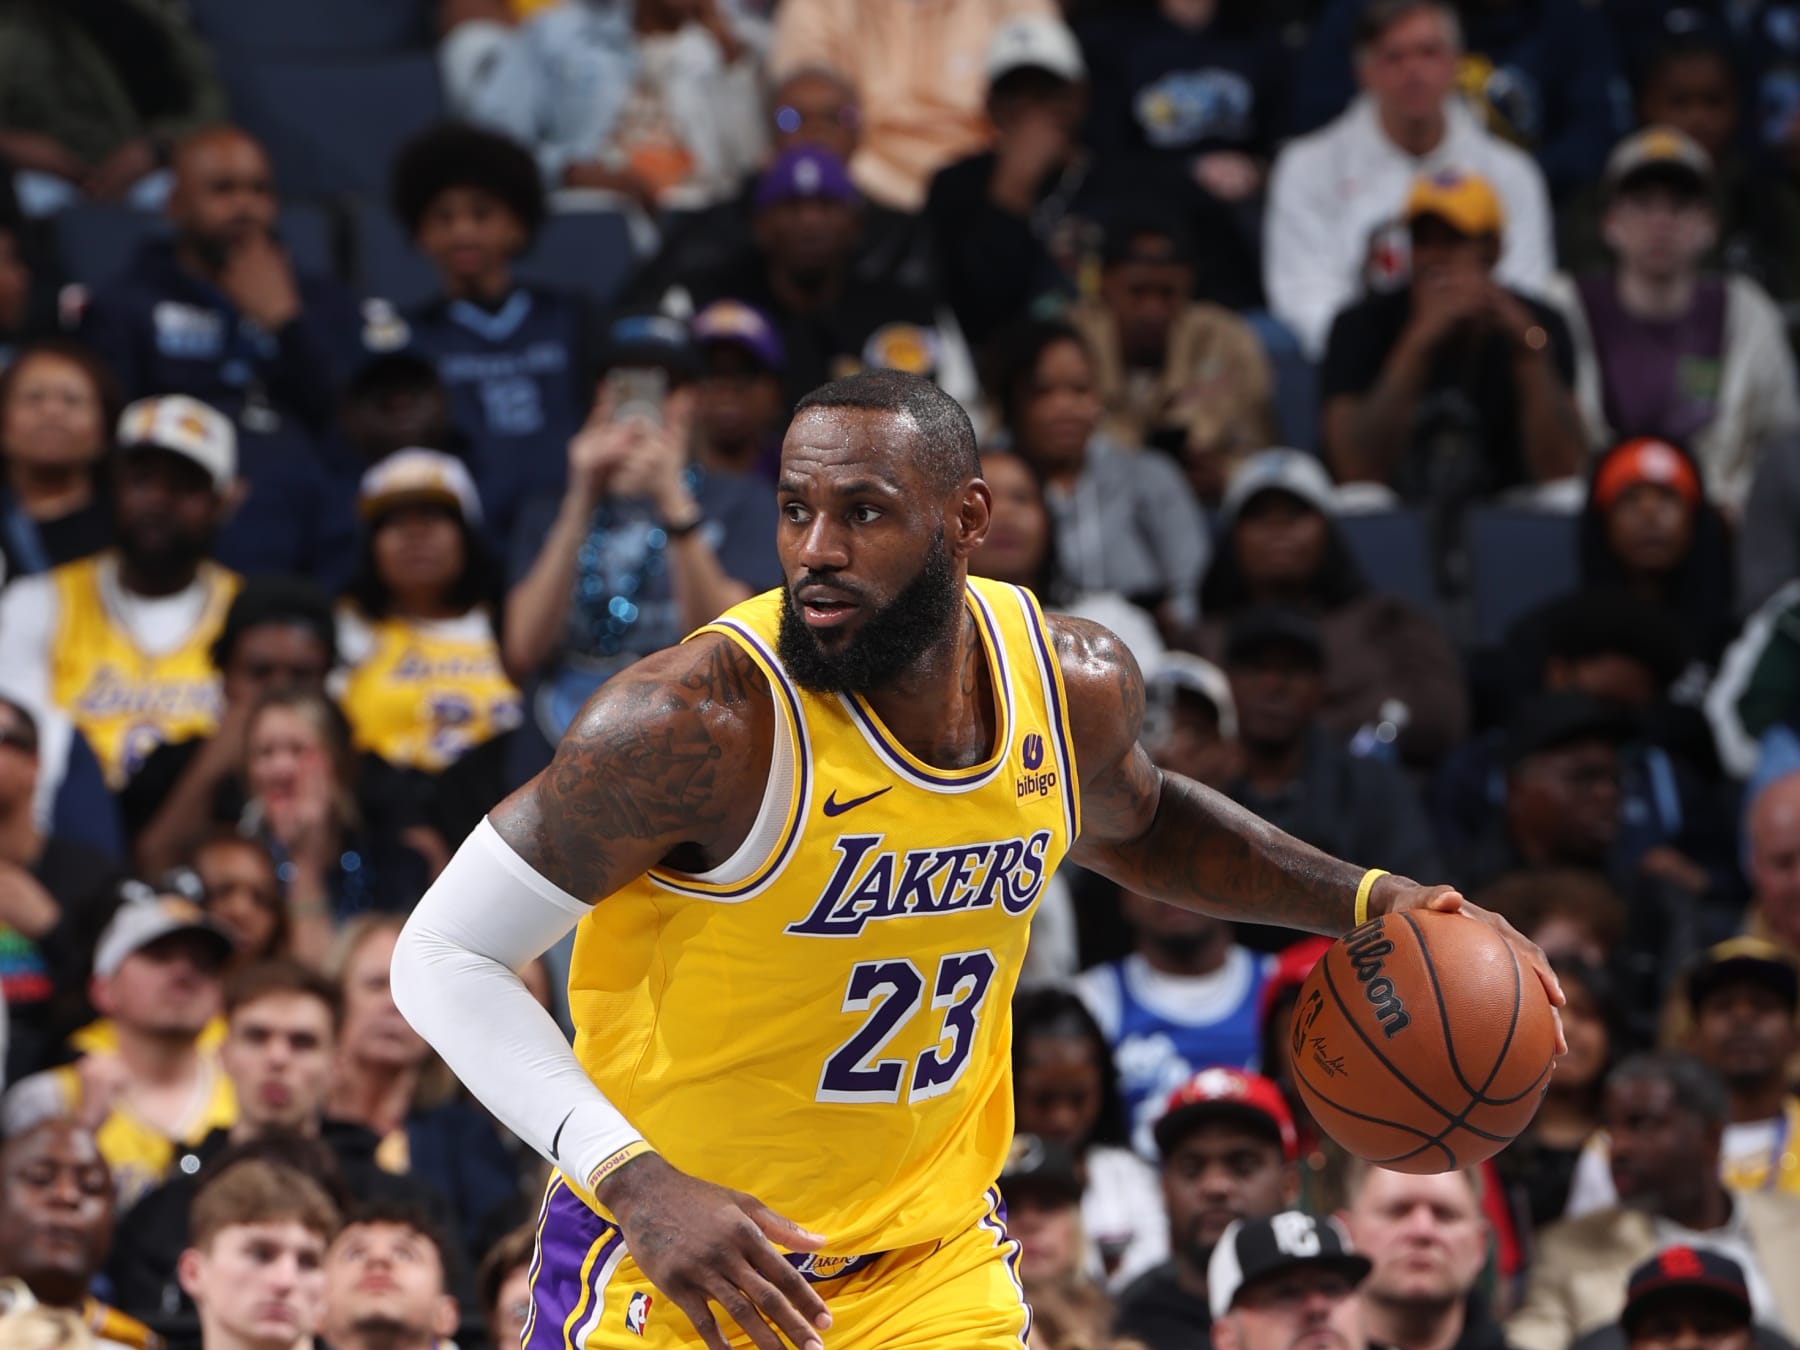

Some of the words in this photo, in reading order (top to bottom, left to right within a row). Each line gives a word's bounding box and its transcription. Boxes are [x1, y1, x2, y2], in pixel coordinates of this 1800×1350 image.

[1016, 772, 1057, 798] bibigo
[782, 828, 1053, 938] LAKERS
[815, 948, 999, 1105] 23
[589, 1153, 626, 1188] PROMISE
